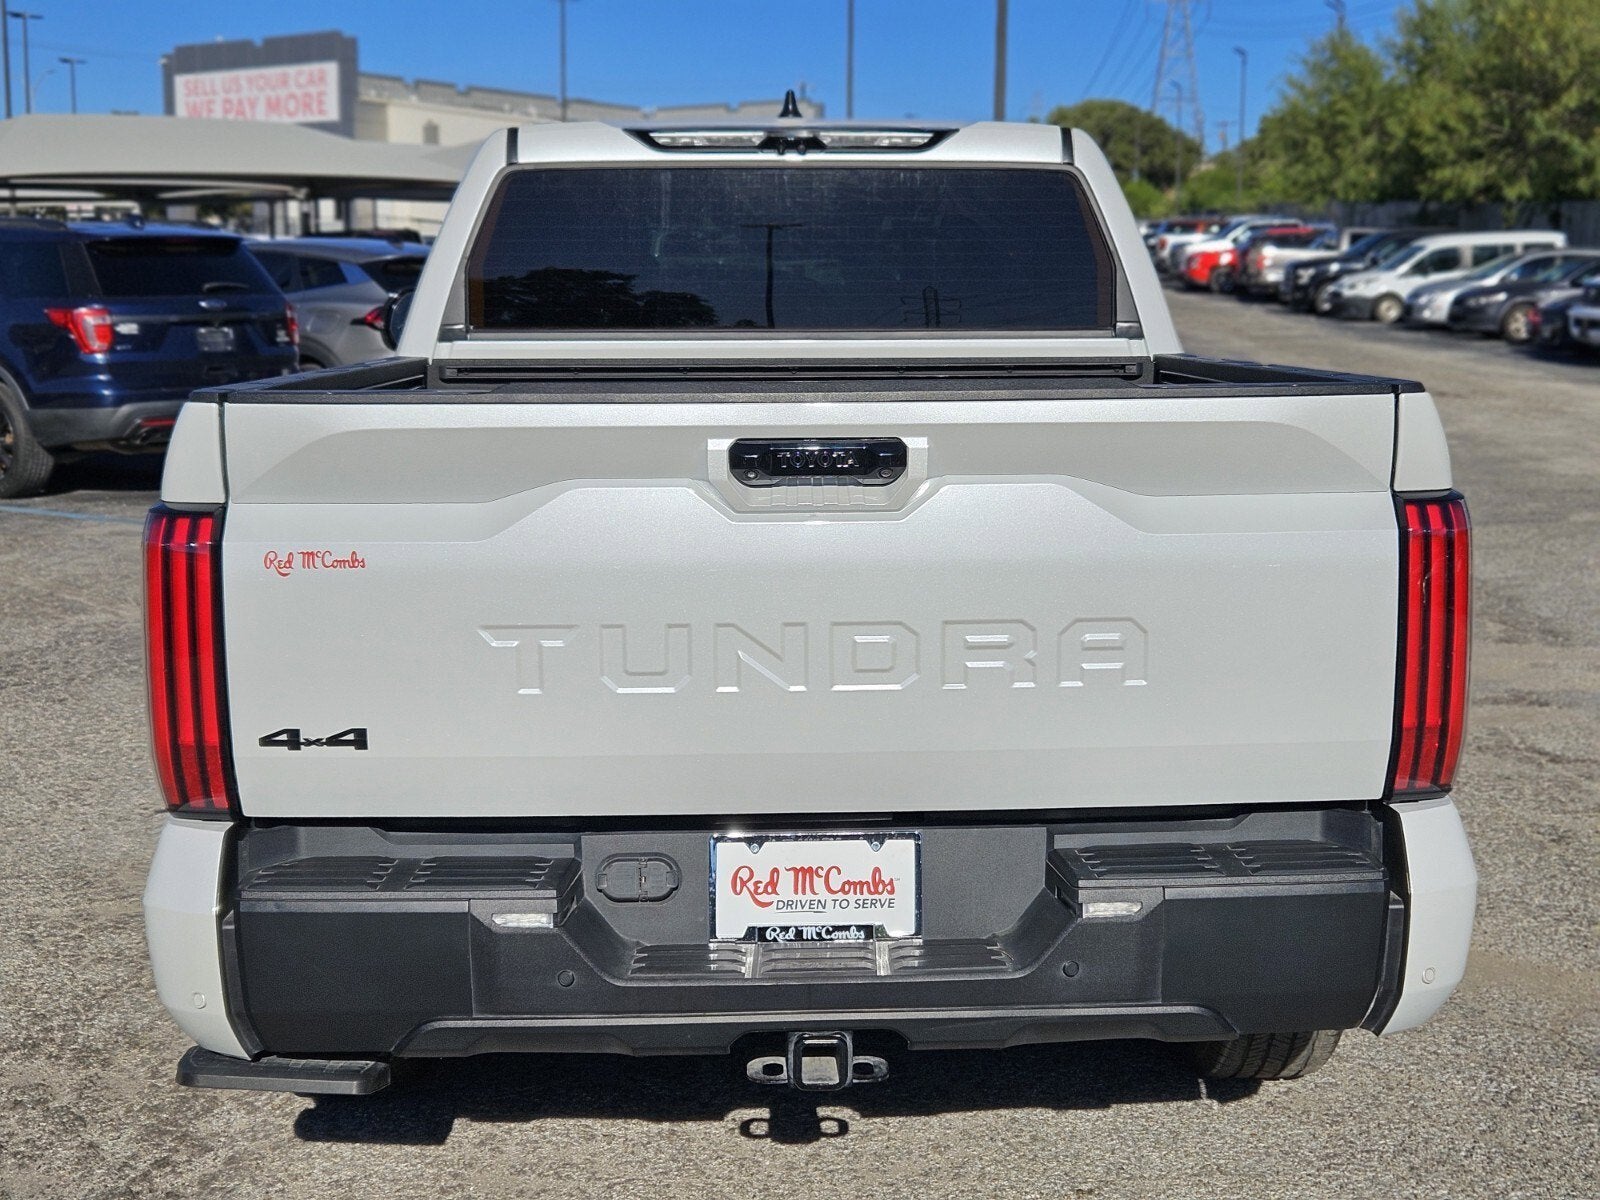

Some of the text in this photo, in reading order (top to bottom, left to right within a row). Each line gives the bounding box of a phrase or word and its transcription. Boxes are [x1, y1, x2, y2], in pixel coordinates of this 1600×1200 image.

[183, 78, 217, 97] SELL
[245, 71, 289, 92] YOUR
[294, 68, 327, 88] CAR
[222, 96, 259, 119] PAY
[265, 91, 328, 118] MORE
[777, 451, 860, 468] TOYOTA
[263, 550, 366, 577] Red McCombs
[476, 616, 1149, 695] TUNDRA
[259, 728, 368, 751] 4x4
[731, 865, 896, 908] Red McCombs
[775, 897, 896, 911] DRIVEN TO SERVE
[765, 925, 866, 942] Red McCombs
